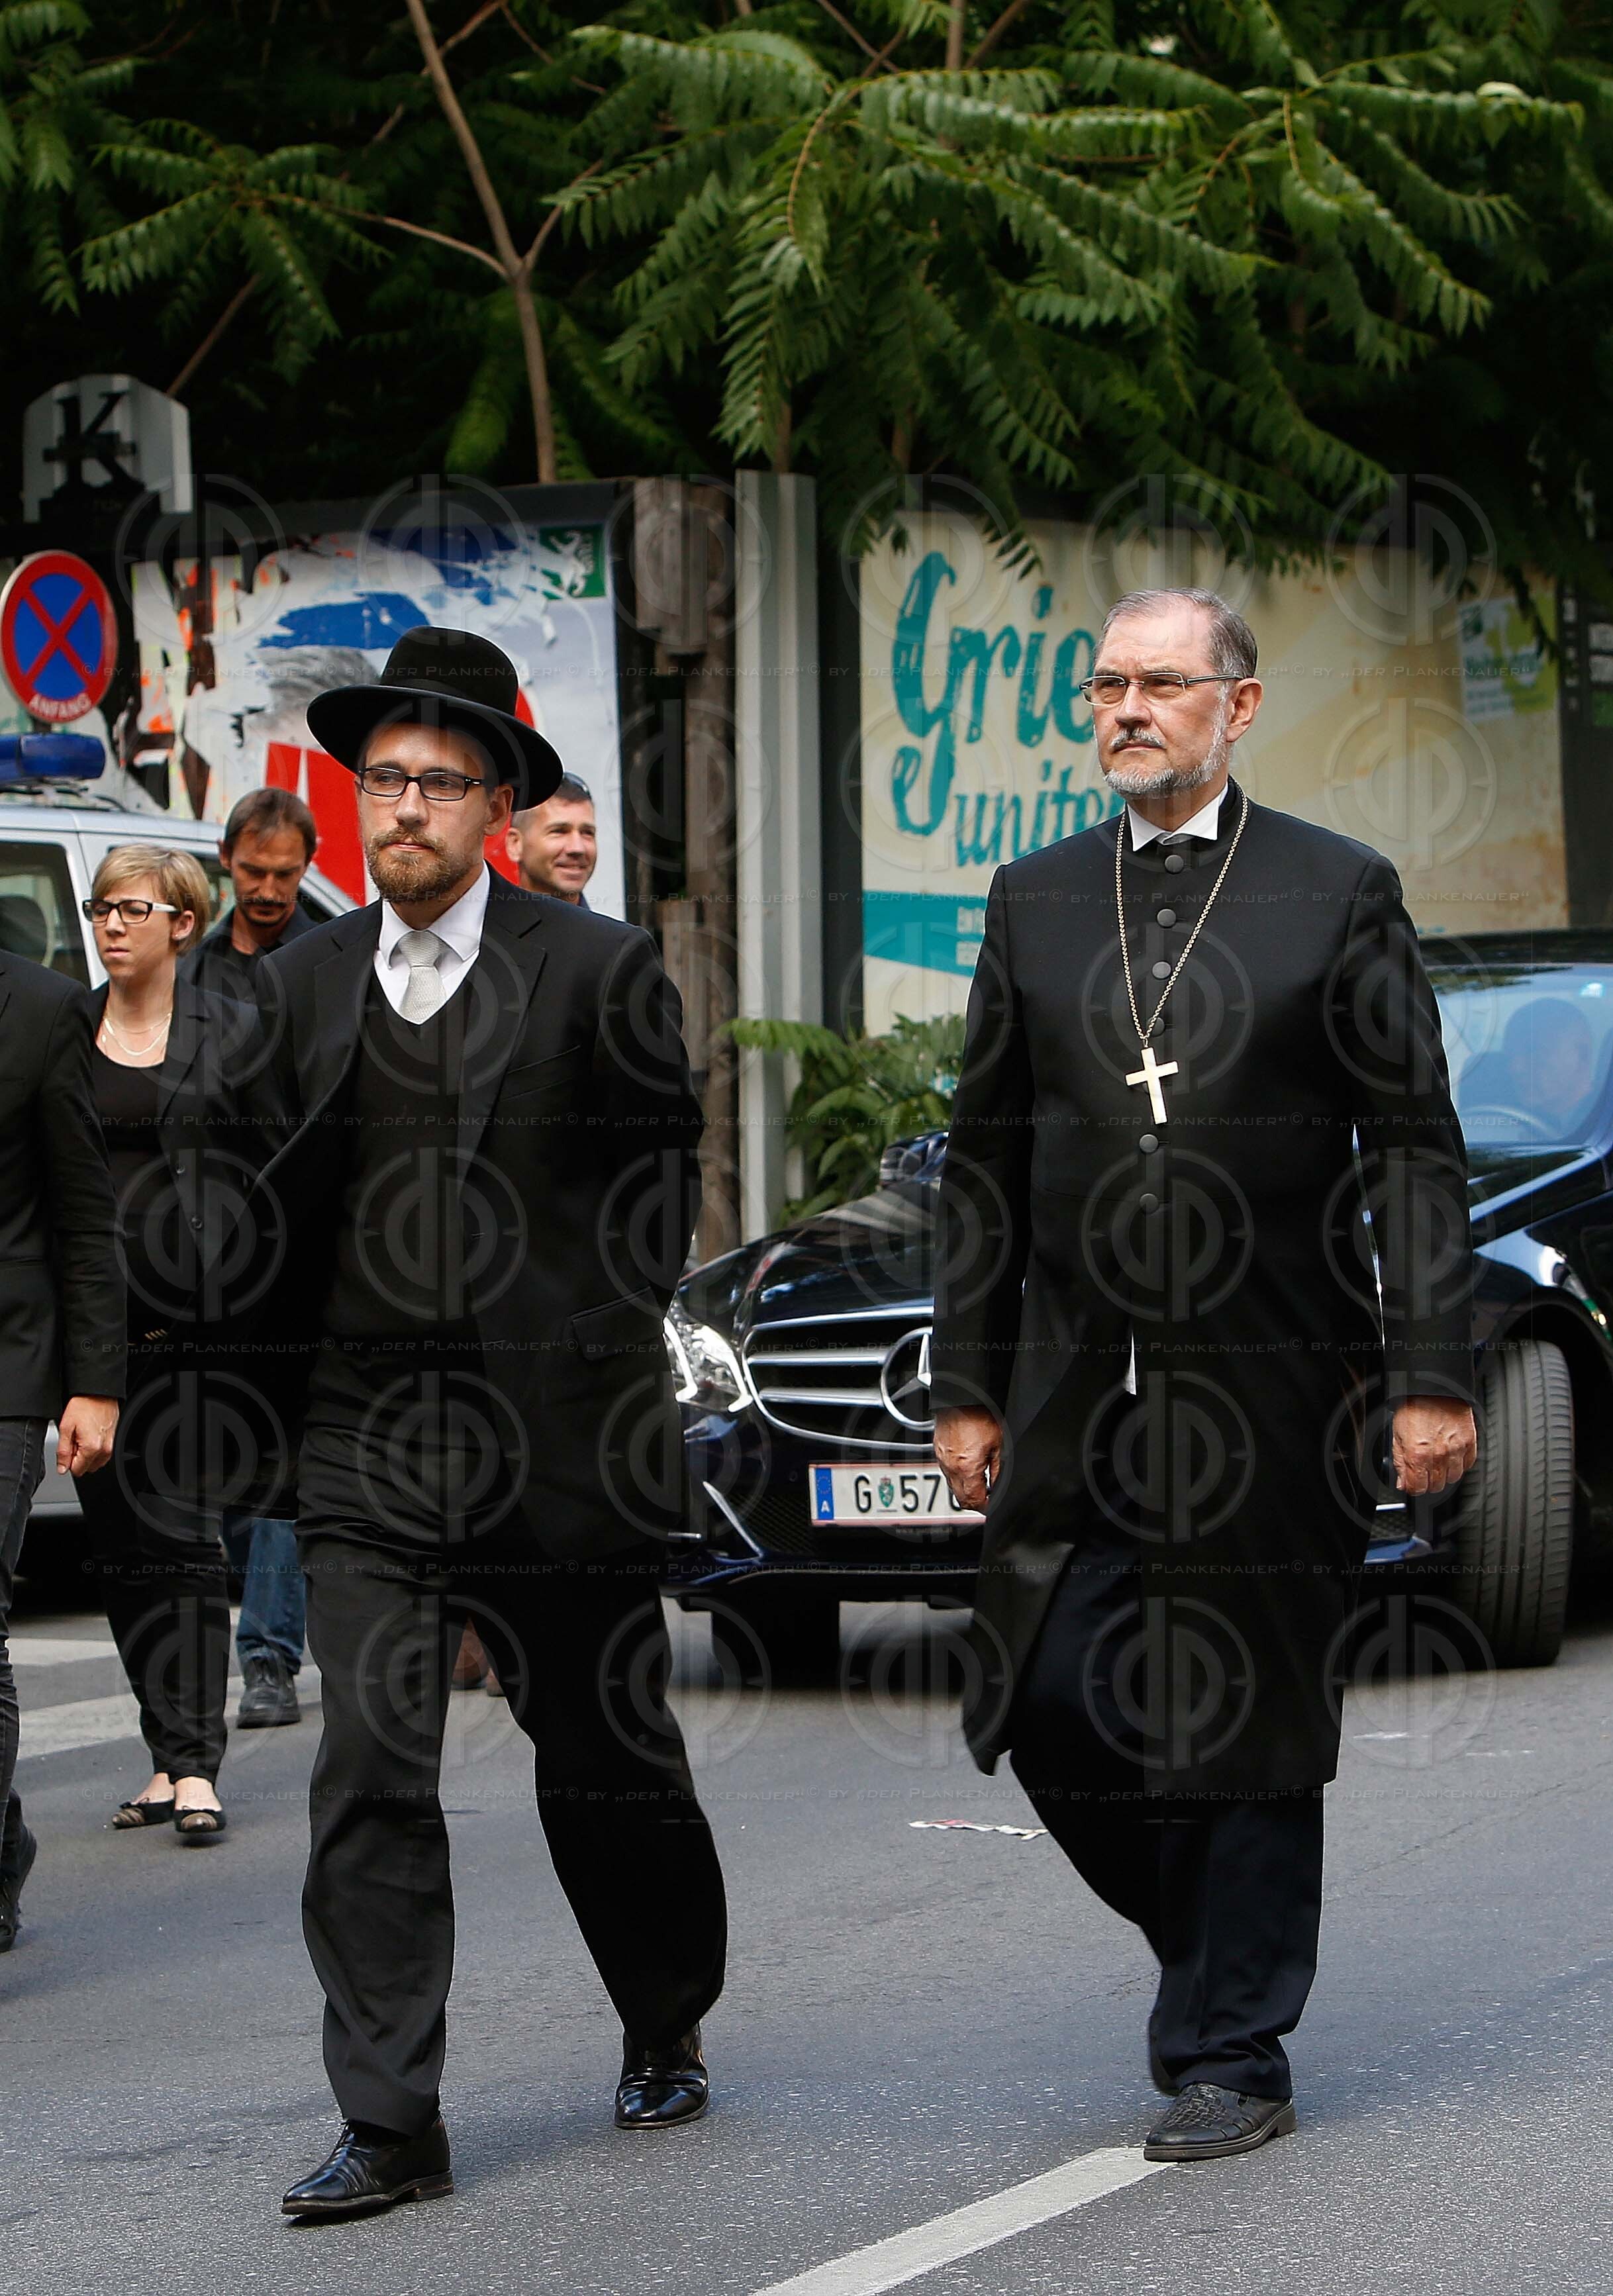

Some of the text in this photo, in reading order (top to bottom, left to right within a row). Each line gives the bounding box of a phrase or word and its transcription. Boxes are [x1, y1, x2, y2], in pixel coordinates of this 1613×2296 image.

[892, 551, 1095, 836] Grie
[820, 1500, 830, 1513] A
[855, 1474, 871, 1513] G
